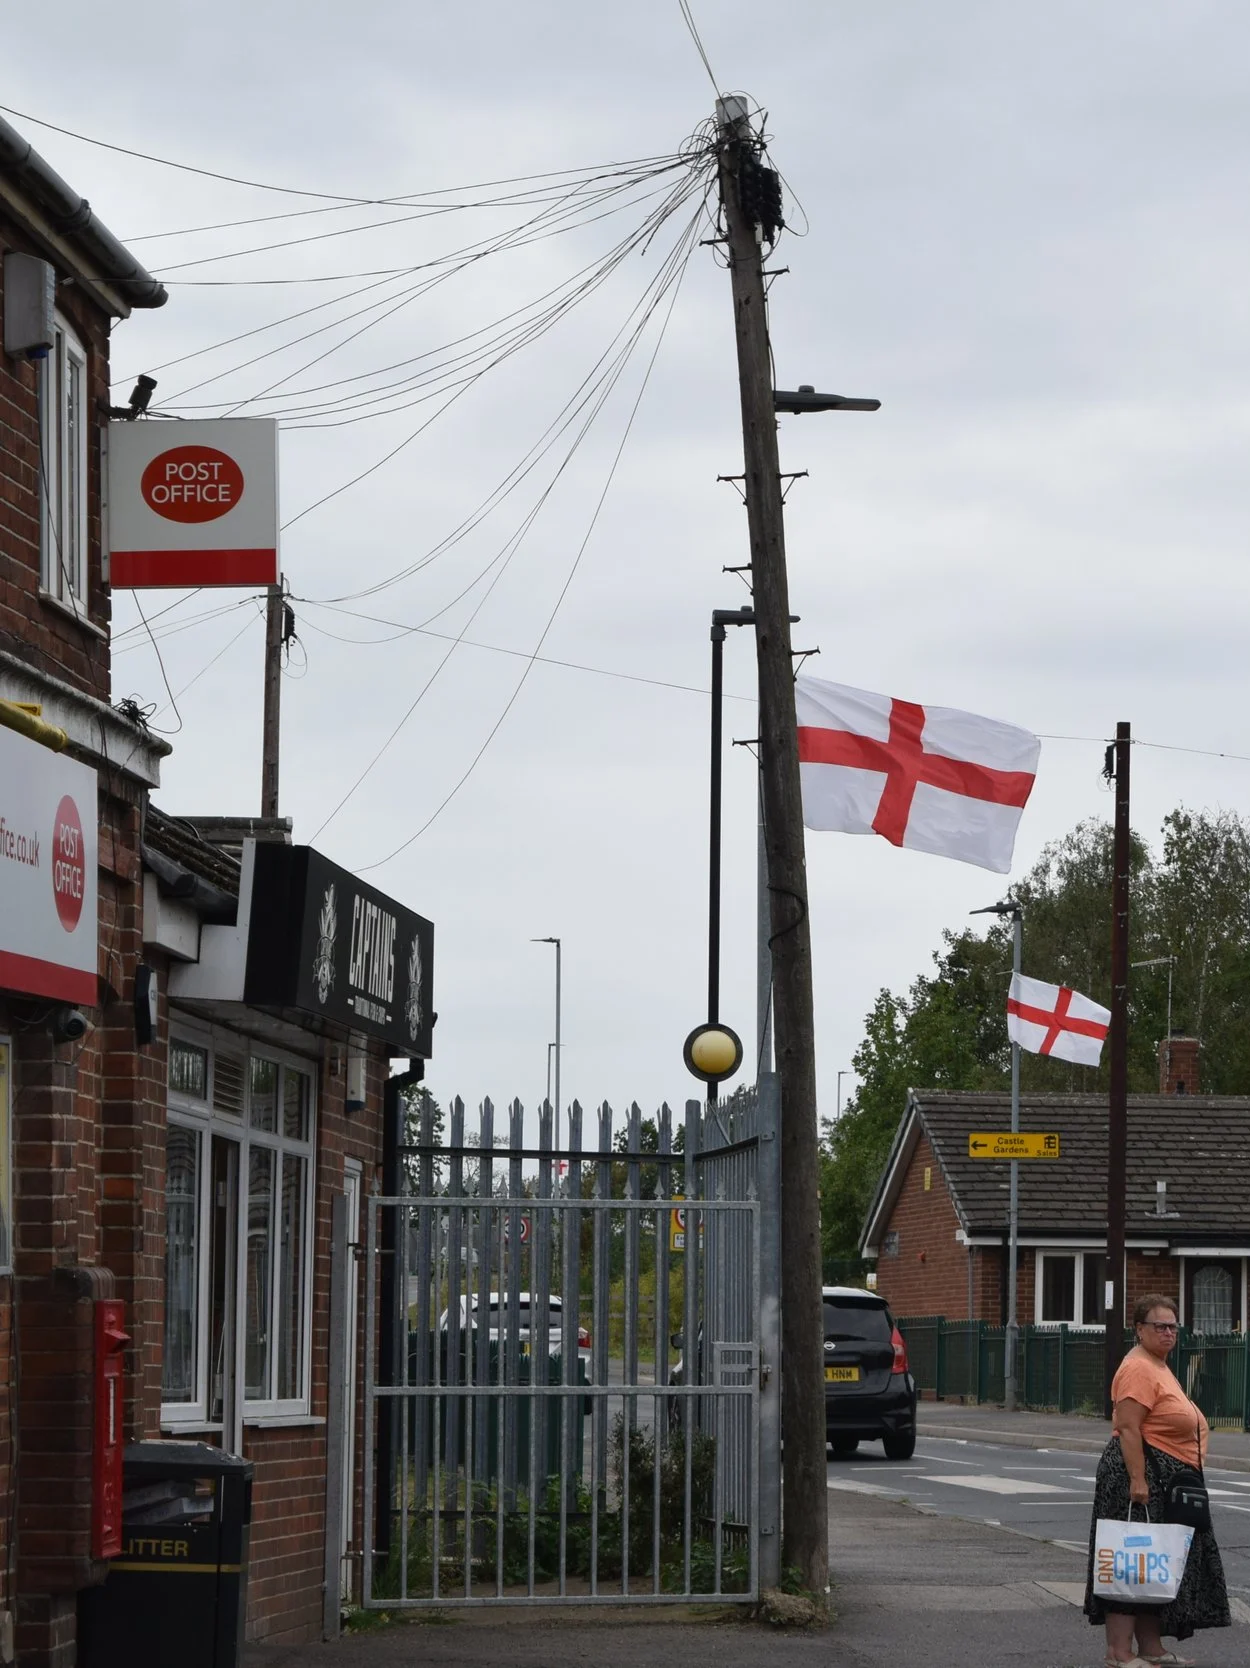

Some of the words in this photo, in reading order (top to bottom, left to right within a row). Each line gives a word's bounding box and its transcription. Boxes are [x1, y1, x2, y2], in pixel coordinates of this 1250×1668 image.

[165, 462, 223, 481] POST
[151, 484, 231, 503] OFFICE
[60, 823, 79, 860] POST
[55, 859, 81, 899] OFFICE
[349, 894, 396, 1003] CAPTAINS
[993, 1145, 1029, 1154] Gardens
[997, 1136, 1025, 1146] Castle
[121, 1538, 189, 1557] ITTER
[1098, 1548, 1114, 1584] AND
[1113, 1550, 1169, 1585] CHIPS
